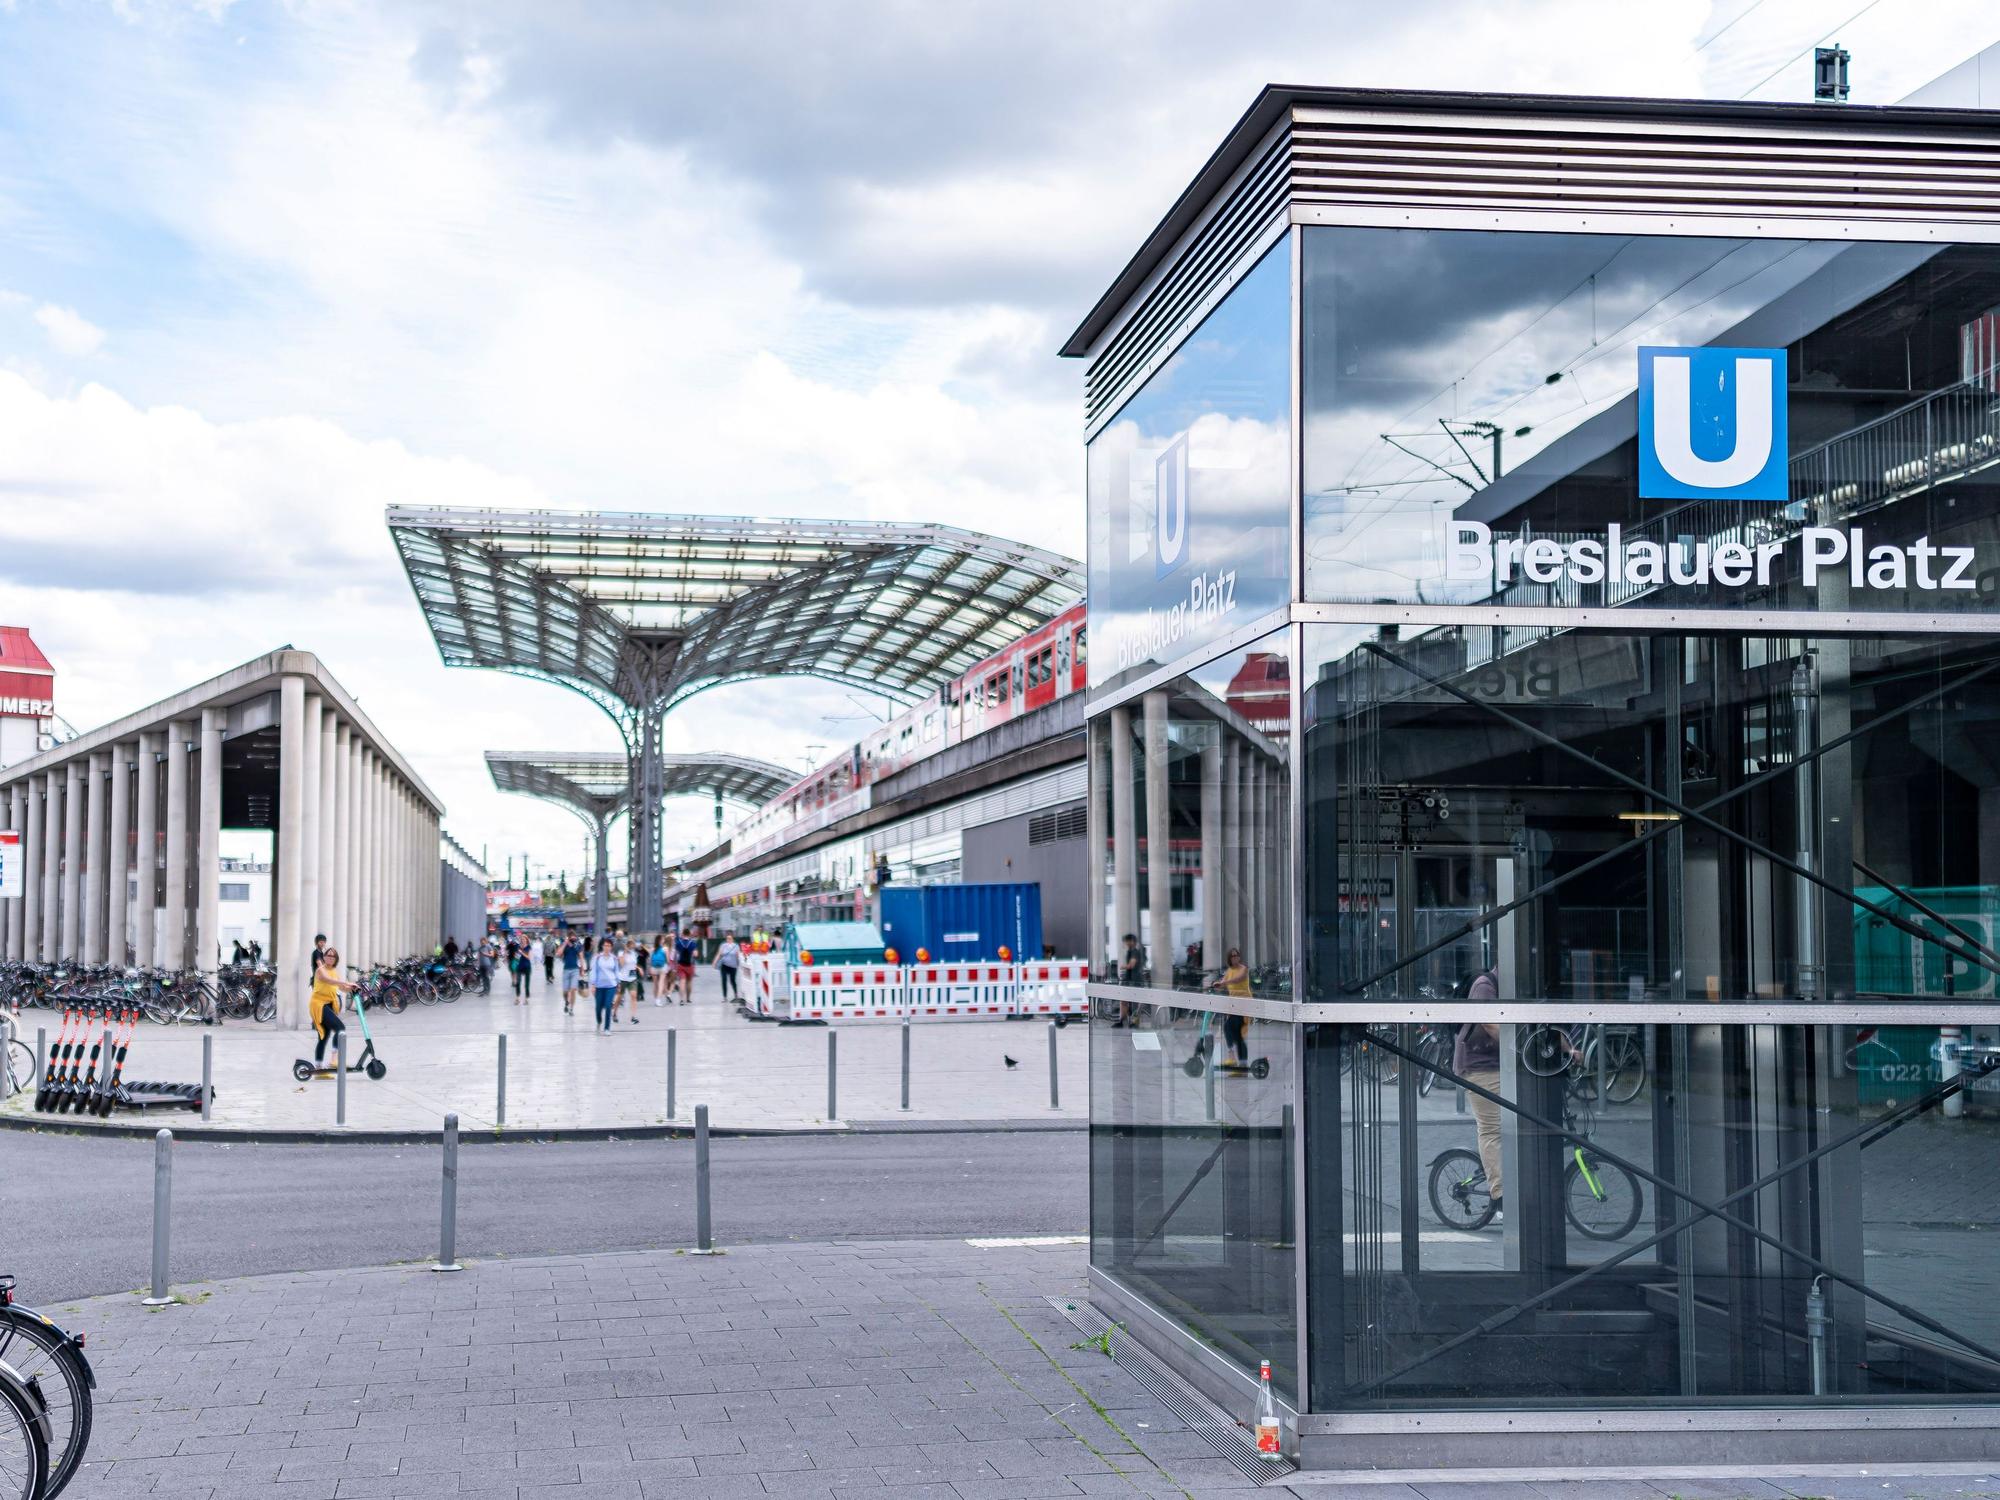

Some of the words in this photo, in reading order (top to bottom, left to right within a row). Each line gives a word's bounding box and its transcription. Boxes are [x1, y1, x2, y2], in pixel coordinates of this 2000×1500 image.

[1653, 356, 1773, 488] U
[1158, 442, 1186, 565] U
[1446, 520, 1783, 586] Breslauer
[1802, 526, 1977, 589] Platz
[1117, 598, 1187, 670] Breslauer
[1191, 568, 1237, 629] Platz
[0, 696, 53, 716] MERZ
